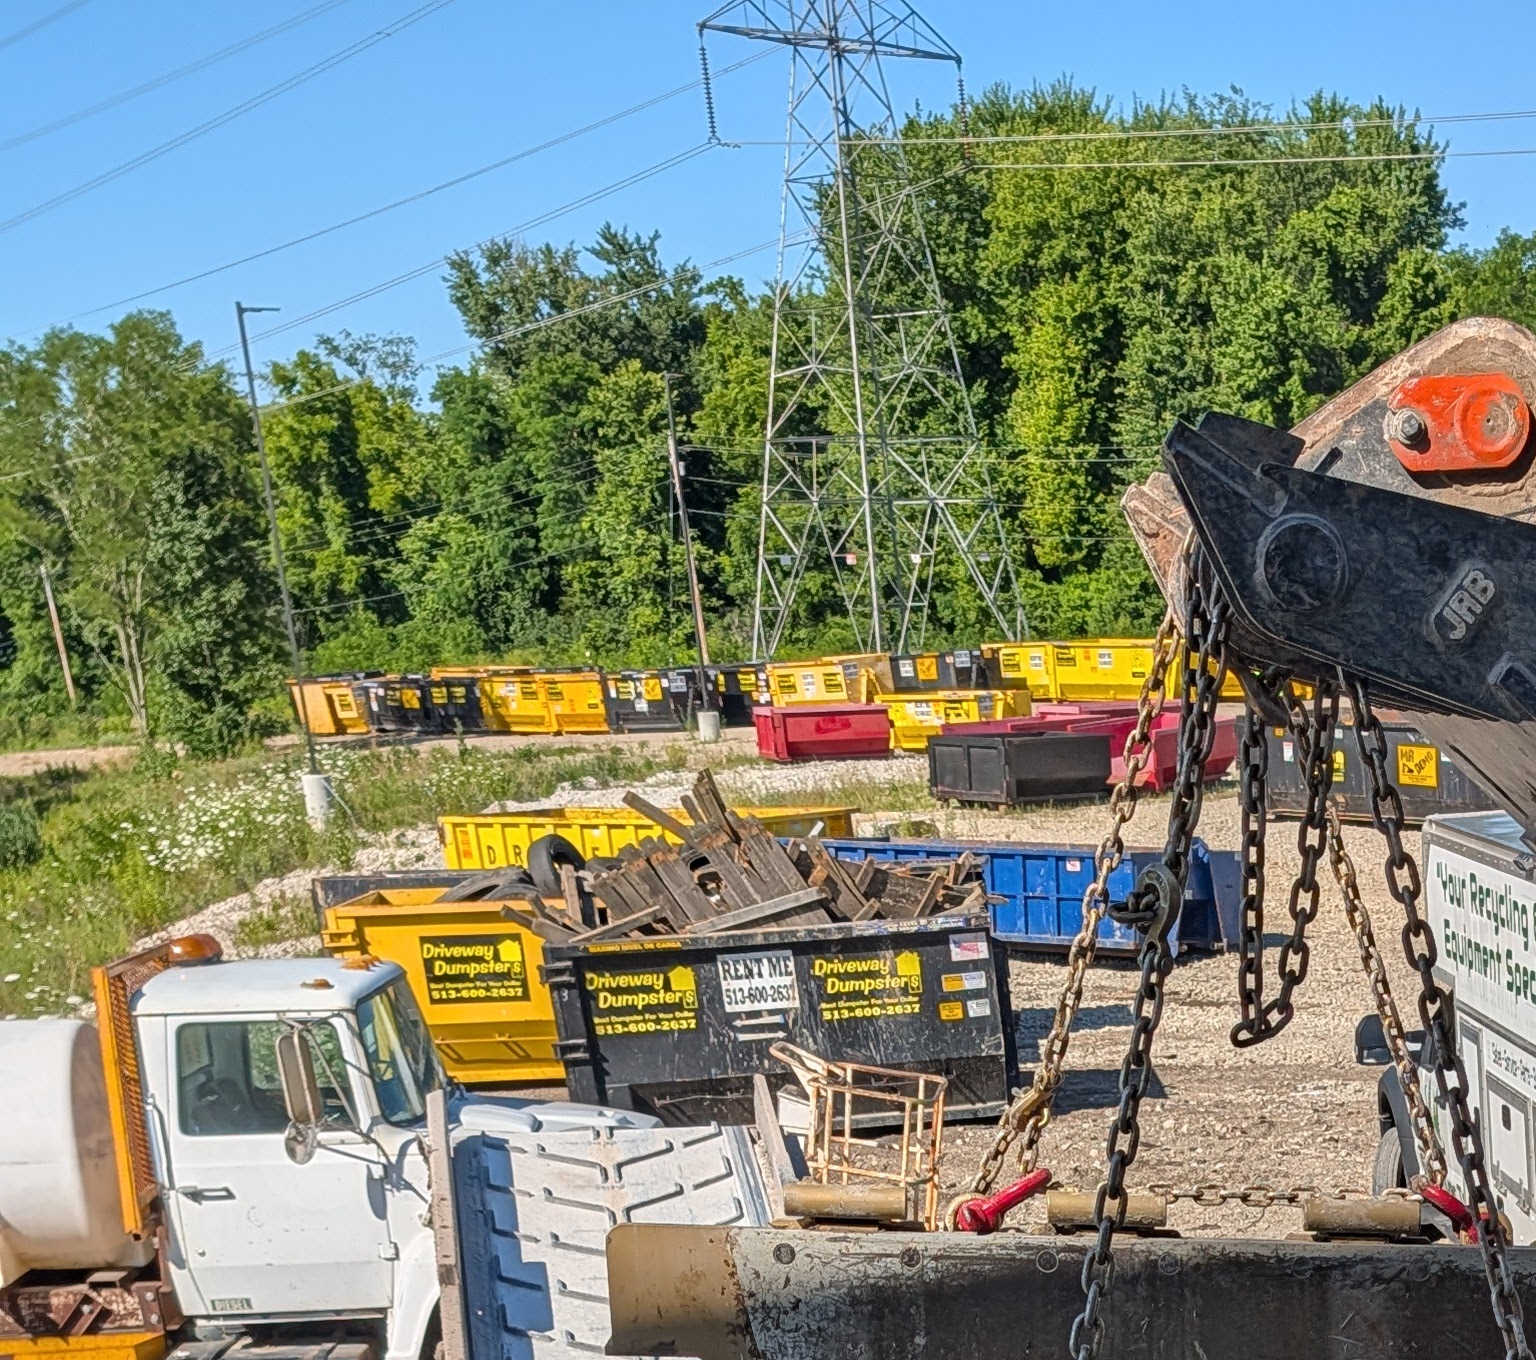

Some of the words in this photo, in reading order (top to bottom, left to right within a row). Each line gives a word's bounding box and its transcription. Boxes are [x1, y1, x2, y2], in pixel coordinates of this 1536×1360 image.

[1401, 749, 1414, 763] MR
[1414, 751, 1434, 774] DEMO
[1436, 861, 1466, 909] "Your
[1469, 872, 1528, 951] Recycling
[423, 943, 494, 960] Driveway
[1444, 918, 1501, 985] Equipment
[721, 958, 763, 981] RENT
[768, 956, 793, 978] ME
[815, 959, 890, 976] Driveway
[585, 971, 664, 990] Driveway
[431, 987, 523, 999] 513-600-2637
[822, 1004, 920, 1020] 513-600-2637
[595, 1019, 696, 1035] 513-600-2637
